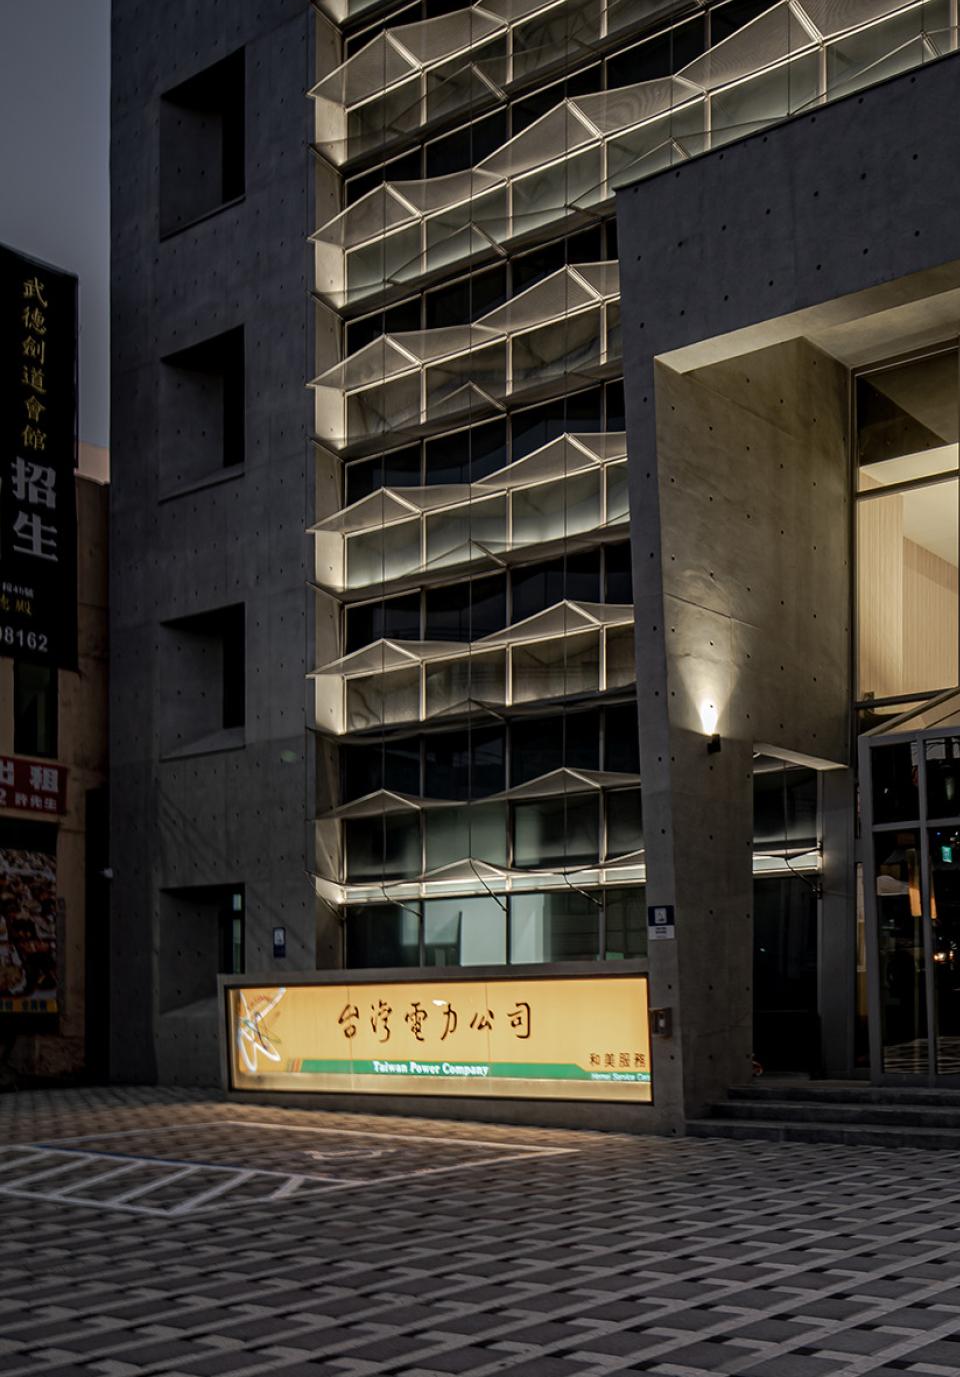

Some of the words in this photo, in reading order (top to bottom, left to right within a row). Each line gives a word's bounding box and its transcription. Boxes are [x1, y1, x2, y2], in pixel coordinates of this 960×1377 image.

[11, 455, 59, 563] 招生
[0, 625, 48, 653] 8162
[338, 999, 533, 1043] 台灣電力公司
[373, 1060, 408, 1074] Taiwan
[410, 1062, 441, 1075] Power
[442, 1063, 490, 1077] Company
